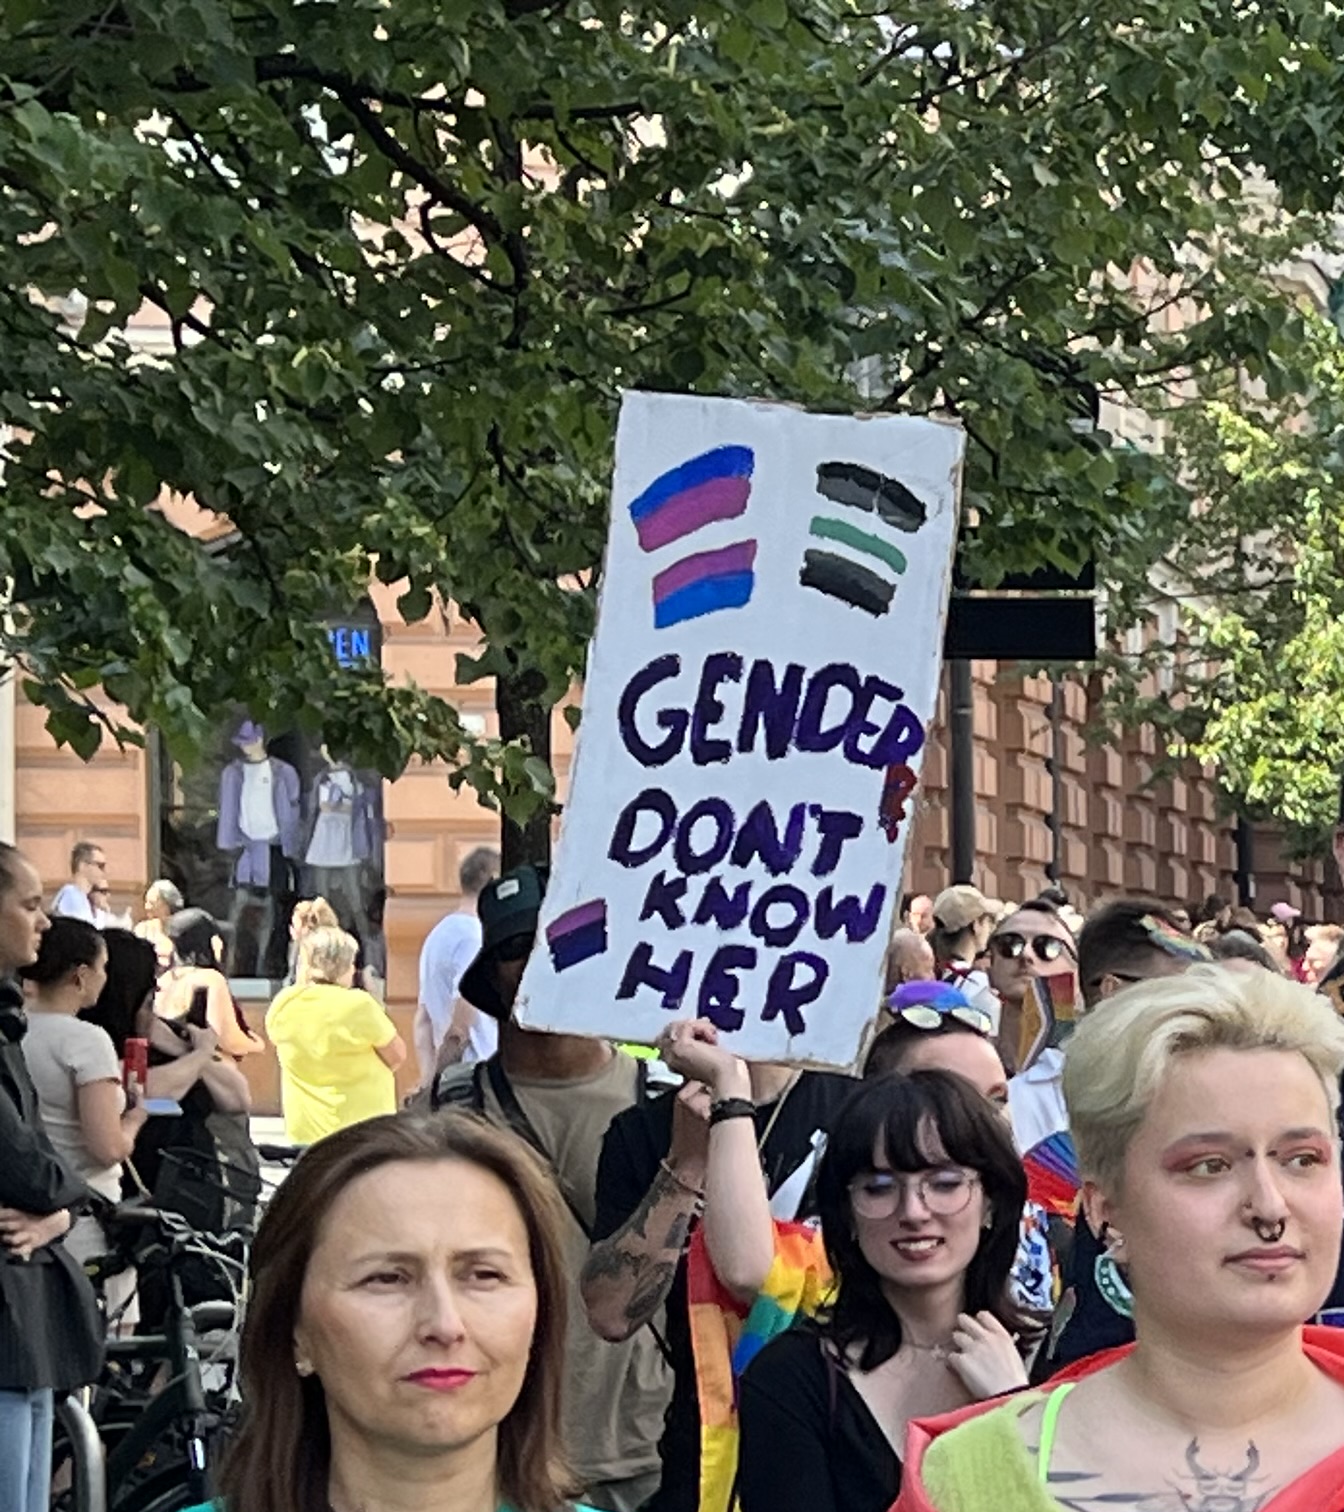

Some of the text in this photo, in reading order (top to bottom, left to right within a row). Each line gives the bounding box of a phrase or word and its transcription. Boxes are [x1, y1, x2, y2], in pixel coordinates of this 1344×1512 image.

[617, 651, 925, 772] GENDER
[638, 870, 887, 948] KNOW
[615, 941, 829, 1036] HER
